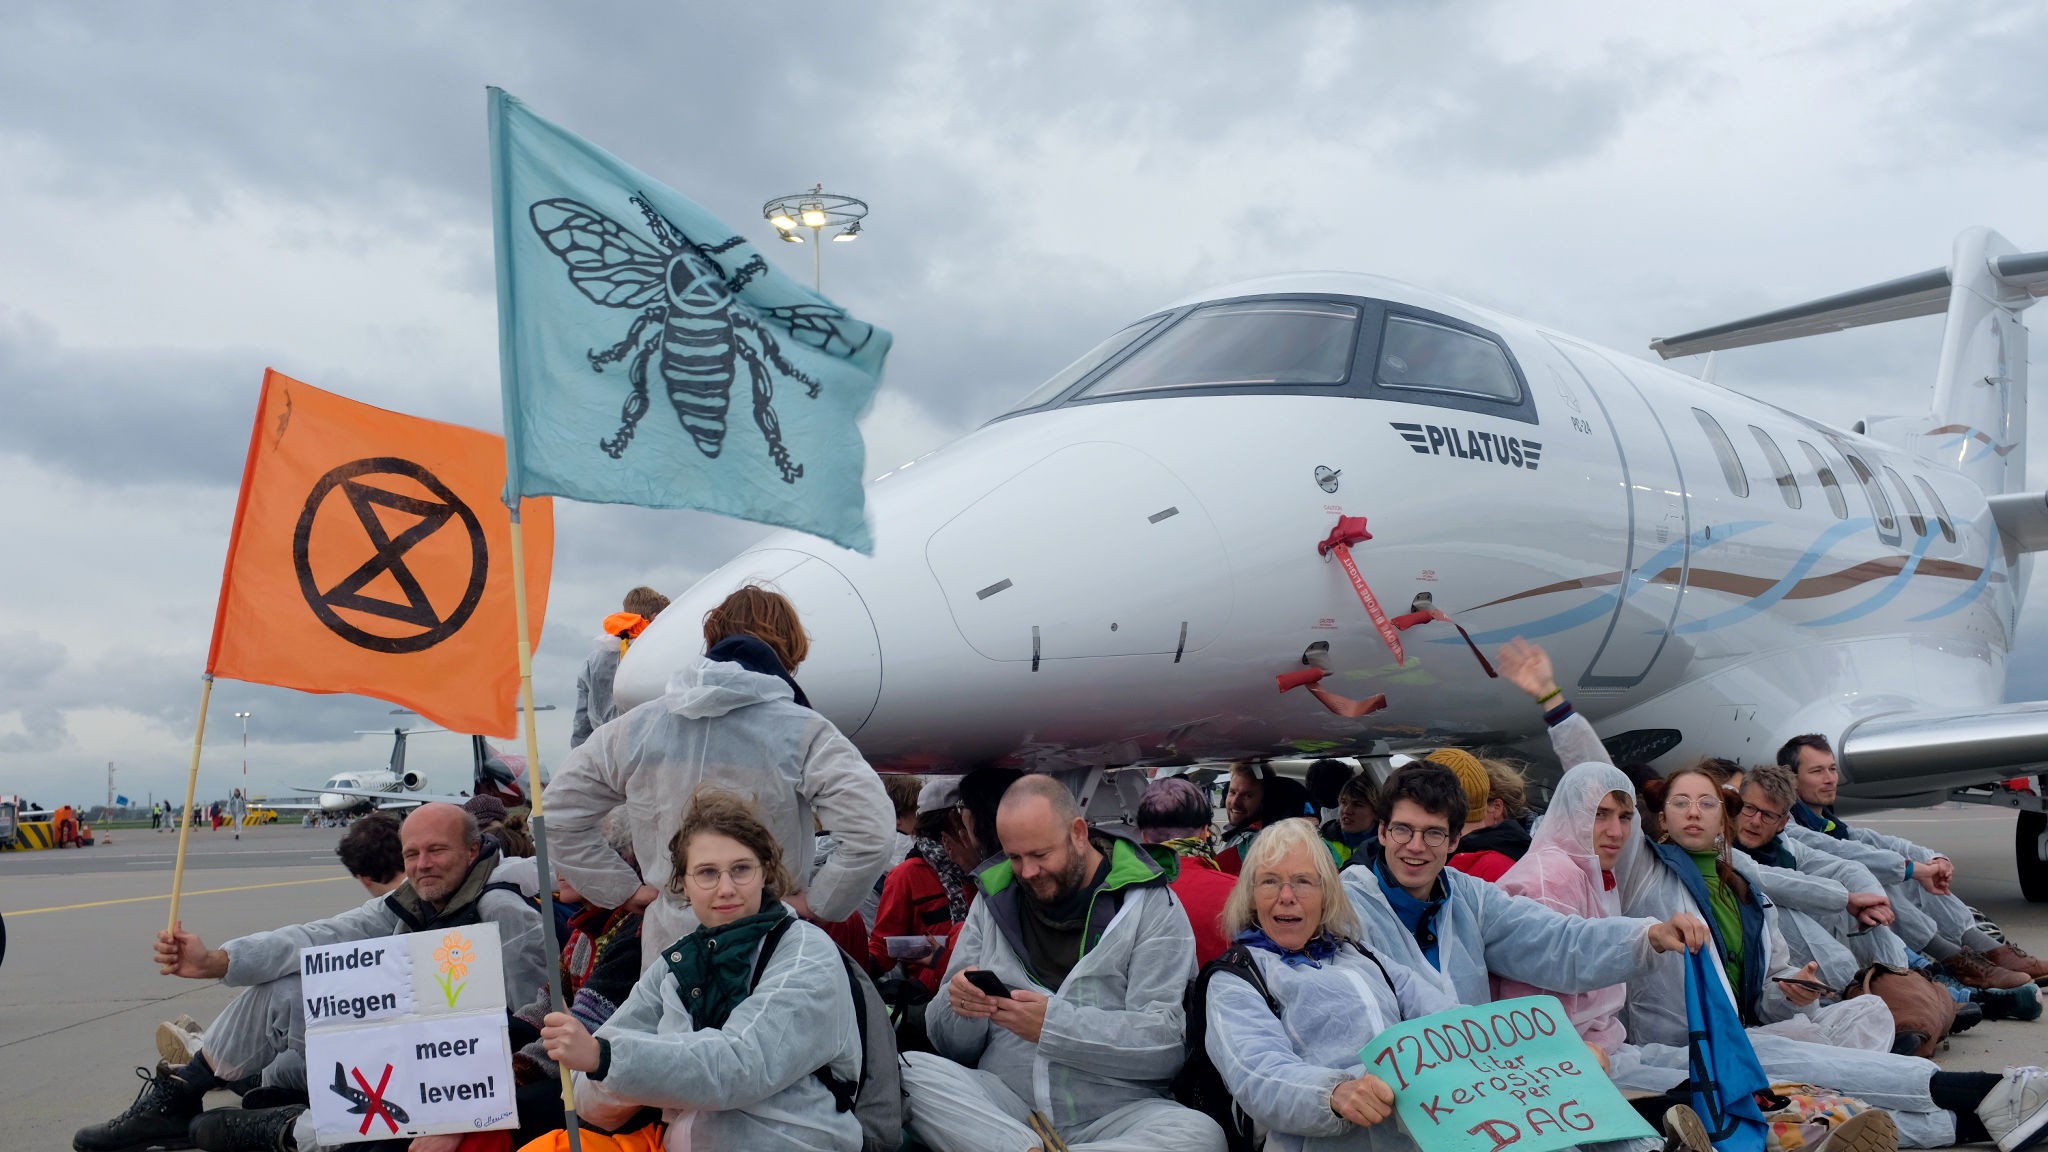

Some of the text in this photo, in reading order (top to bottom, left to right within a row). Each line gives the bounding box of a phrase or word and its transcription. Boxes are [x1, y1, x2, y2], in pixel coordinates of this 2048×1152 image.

[1570, 416, 1592, 435] PC-24
[1425, 425, 1524, 468] PILATUS
[1343, 558, 1365, 589] FLIGHT
[305, 948, 385, 976] Minder
[306, 992, 397, 1019] Vliegen
[415, 1037, 479, 1060] meer
[1374, 1007, 1557, 1091] 72.000.000
[419, 1075, 495, 1104] leven!
[1509, 1084, 1552, 1106] per
[1466, 1099, 1595, 1152] DAG
